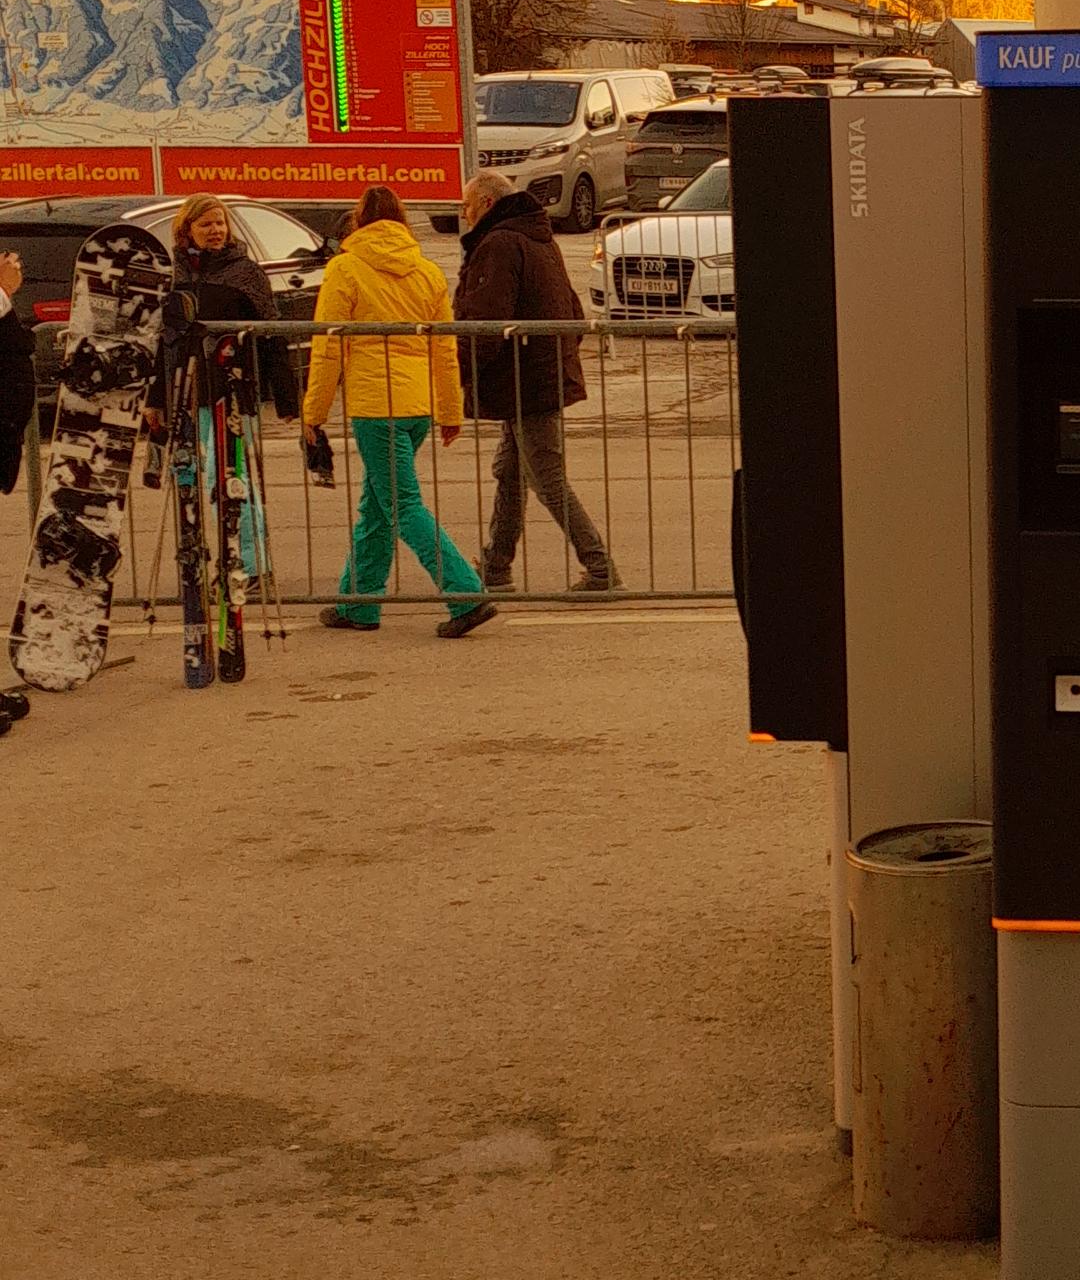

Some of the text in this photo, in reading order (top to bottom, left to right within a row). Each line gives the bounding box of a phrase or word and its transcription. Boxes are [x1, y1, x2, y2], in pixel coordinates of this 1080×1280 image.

[405, 51, 451, 60] ZILLERTAL
[999, 46, 1056, 69] KAUF
[178, 163, 446, 183] www.hochzillertal.com
[849, 118, 868, 217] SKIDATA
